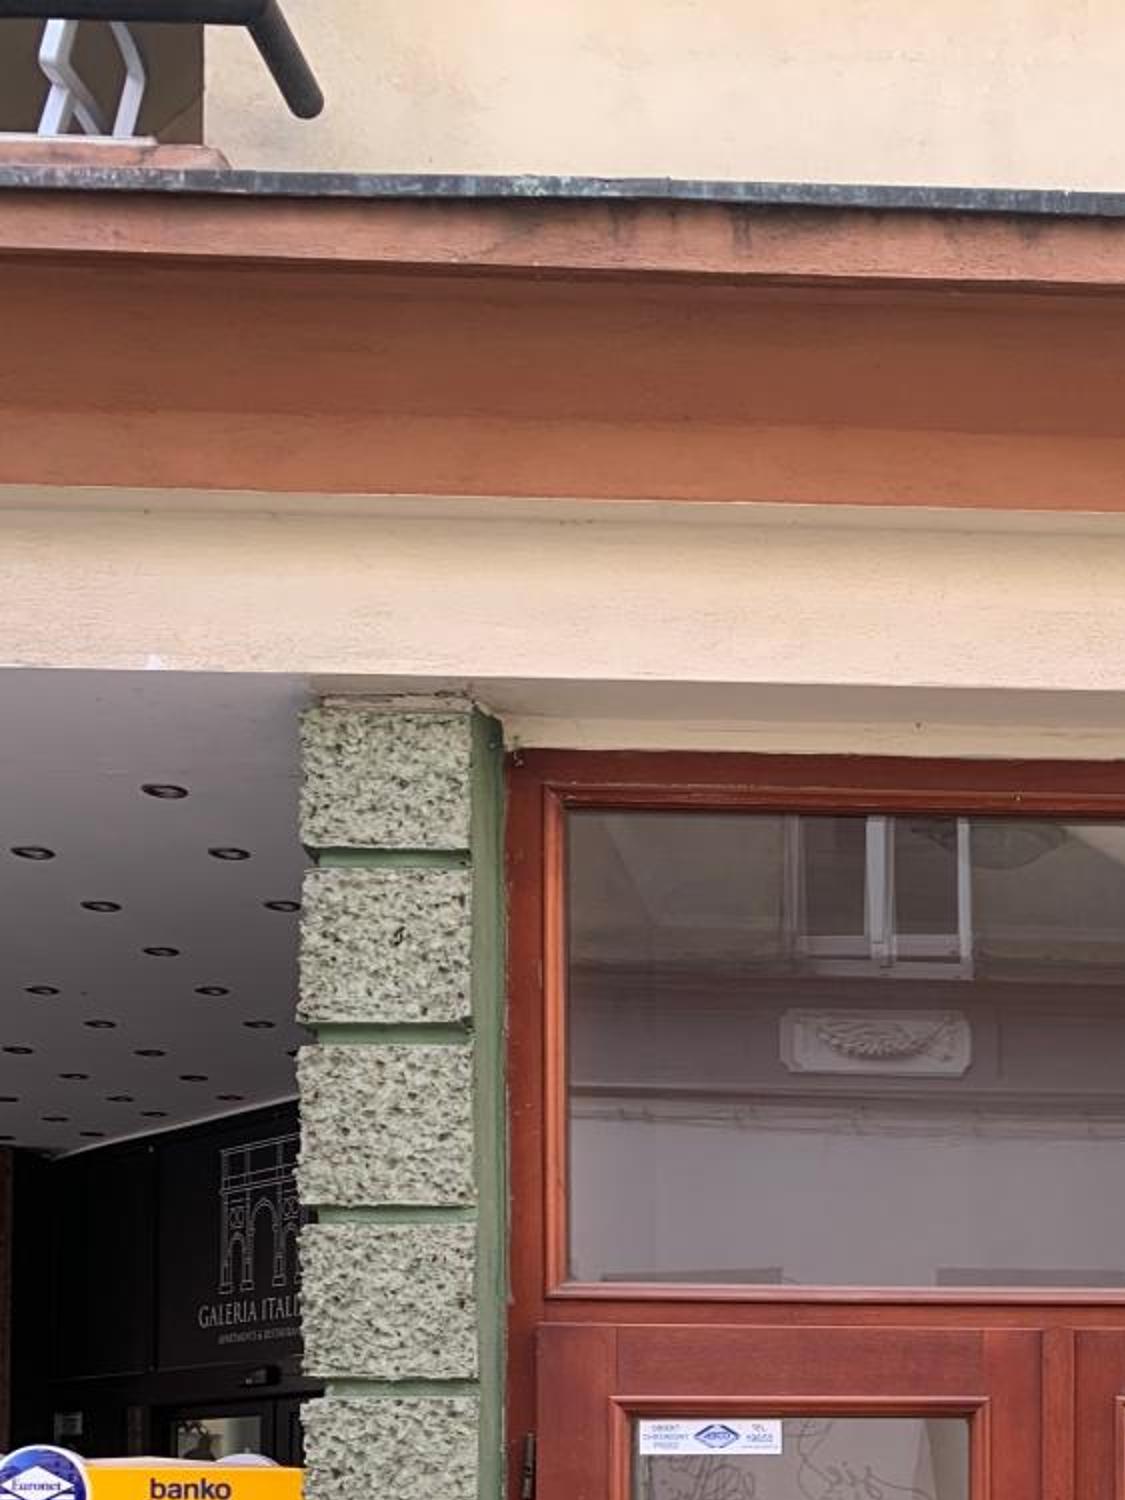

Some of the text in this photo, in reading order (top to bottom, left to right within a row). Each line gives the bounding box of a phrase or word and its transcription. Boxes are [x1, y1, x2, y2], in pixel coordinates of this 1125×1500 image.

[199, 1295, 301, 1328] GALERIA ITALI
[11, 1480, 61, 1491] Euronet
[149, 1478, 232, 1500] banko
